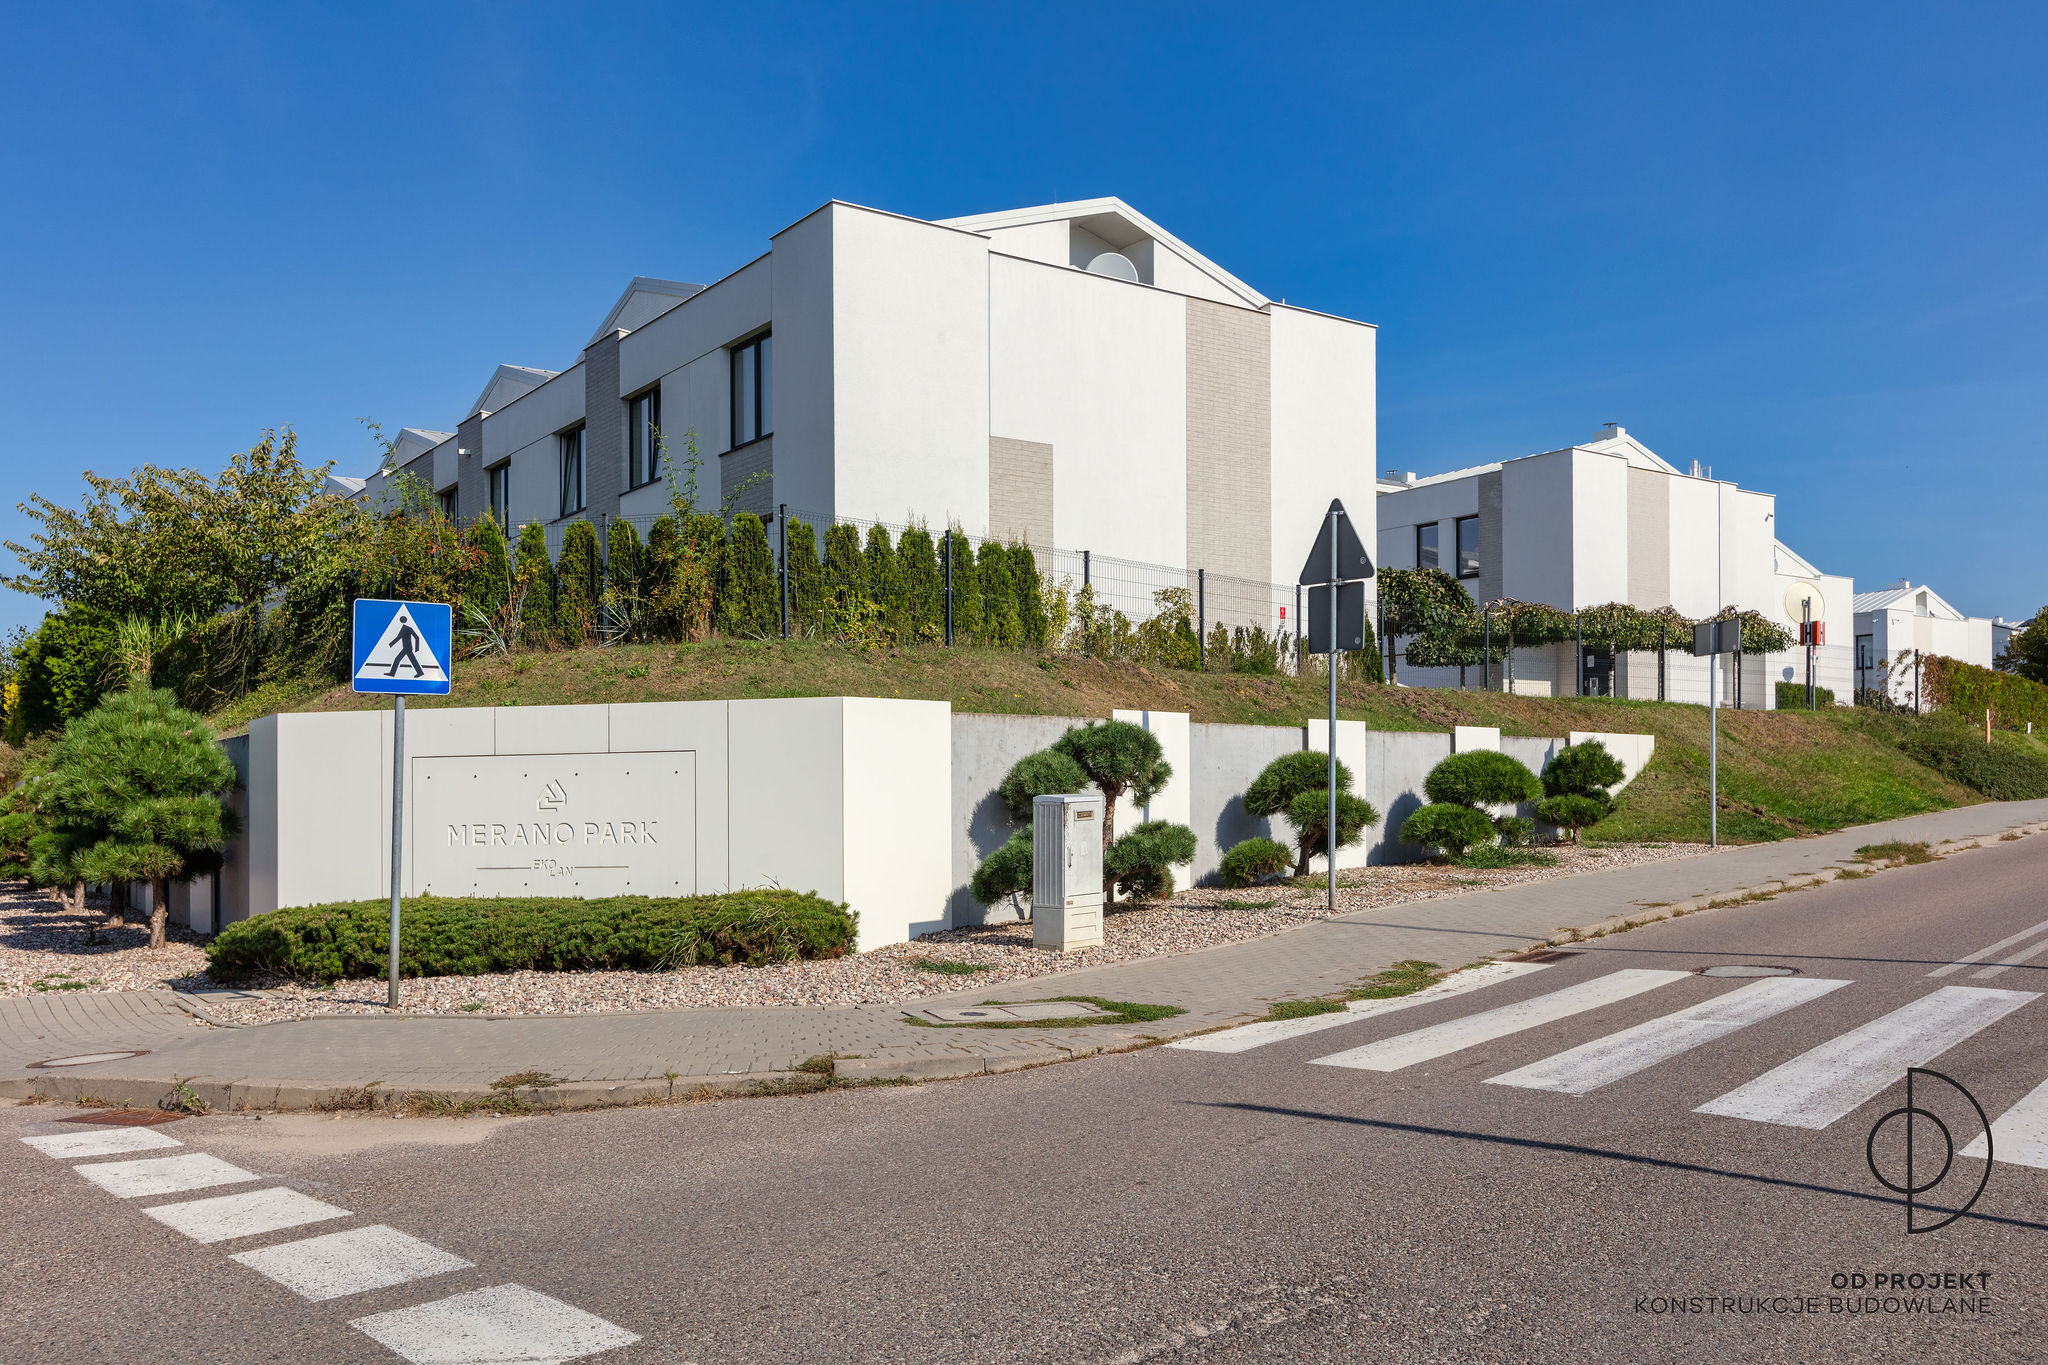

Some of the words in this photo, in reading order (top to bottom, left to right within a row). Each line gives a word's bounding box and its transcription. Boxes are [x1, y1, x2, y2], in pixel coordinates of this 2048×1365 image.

[447, 823, 575, 847] MERANO
[584, 821, 657, 845] PARK
[532, 859, 557, 870] EKO
[549, 866, 574, 877] LAN
